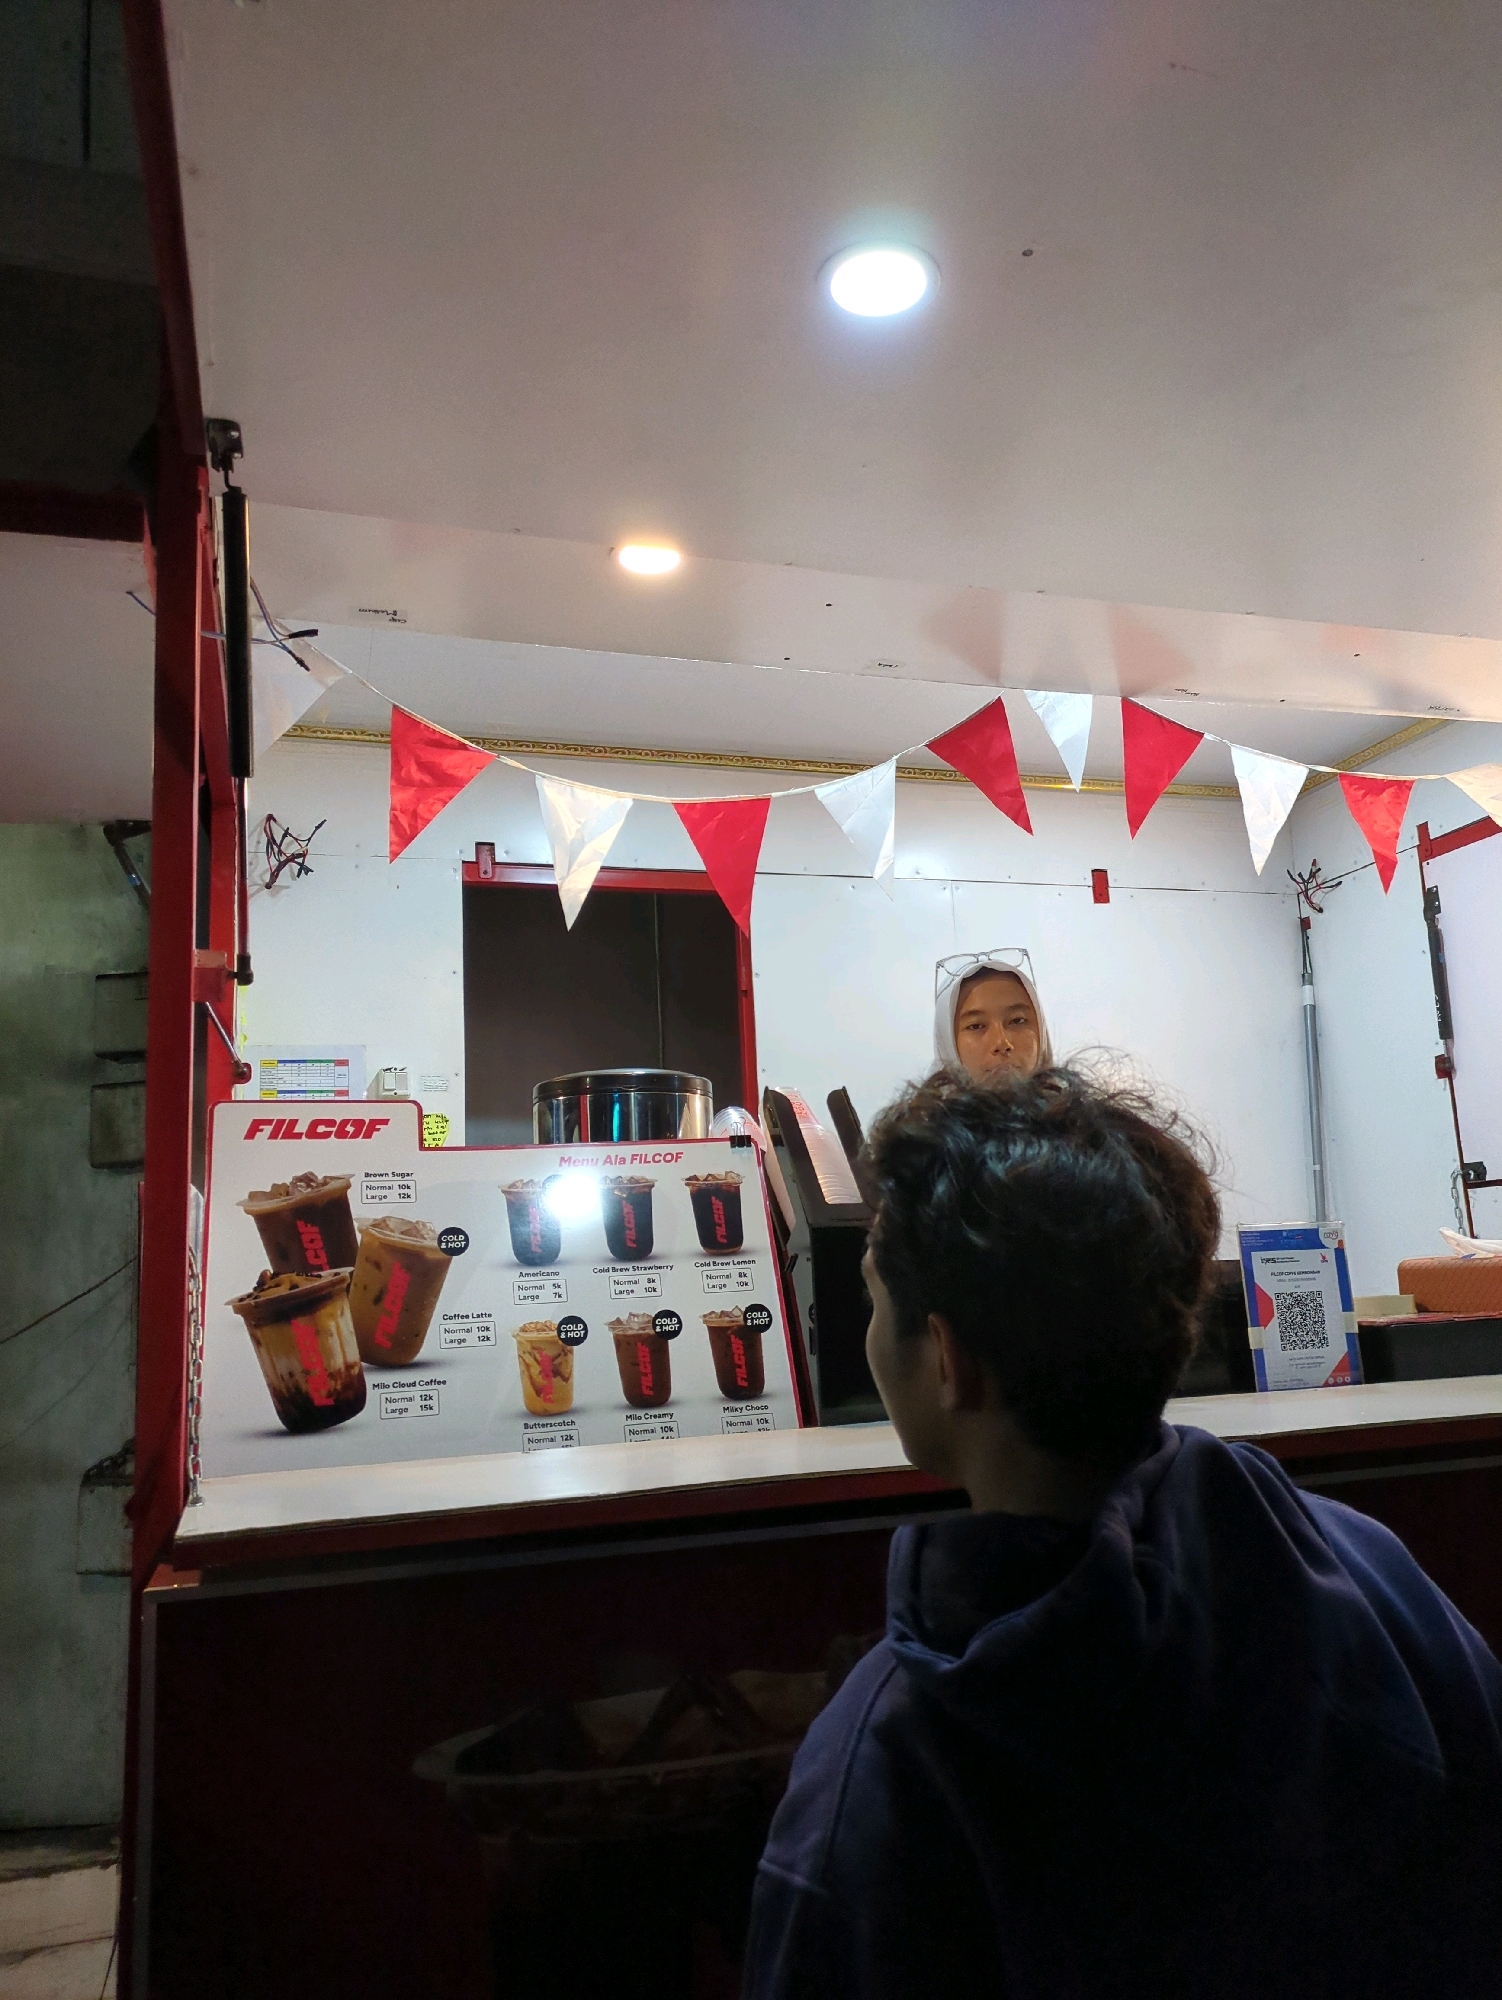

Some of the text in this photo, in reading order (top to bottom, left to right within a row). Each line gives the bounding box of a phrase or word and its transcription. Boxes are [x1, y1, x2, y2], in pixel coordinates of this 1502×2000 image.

[243, 1118, 391, 1141] FILCOF
[558, 1151, 684, 1167] Menu Ala FILCOF
[391, 1171, 414, 1179] Sugar
[366, 1193, 388, 1202] Large
[622, 1200, 637, 1248] FILCOF
[711, 1196, 727, 1243] FILCOF
[632, 1264, 674, 1272] Strawberry
[518, 1270, 560, 1279] Americano
[706, 1272, 732, 1280] Normal
[518, 1284, 545, 1292] Normal
[614, 1288, 635, 1296] Large
[518, 1294, 540, 1302] Large
[374, 1261, 412, 1349] FILCOF
[442, 1313, 470, 1321] Coffee
[444, 1327, 473, 1335] Normal
[662, 1324, 680, 1332] HOT
[567, 1330, 586, 1338] HOT
[444, 1337, 467, 1346] Large
[290, 1319, 335, 1407] FILCOF
[731, 1335, 748, 1387] FILCOF
[637, 1341, 654, 1396] FILCOF
[372, 1379, 447, 1390] Milo Cloud Coffee
[385, 1394, 434, 1404] Normal 12k
[385, 1404, 434, 1415] Large 15k
[723, 1404, 769, 1414] Milky Choco
[625, 1412, 674, 1422] Milo Creamy
[523, 1420, 576, 1430] Butterscotch
[726, 1419, 753, 1428] Normal
[628, 1426, 674, 1436] Normal 10k
[528, 1434, 575, 1445] Normal 12k
